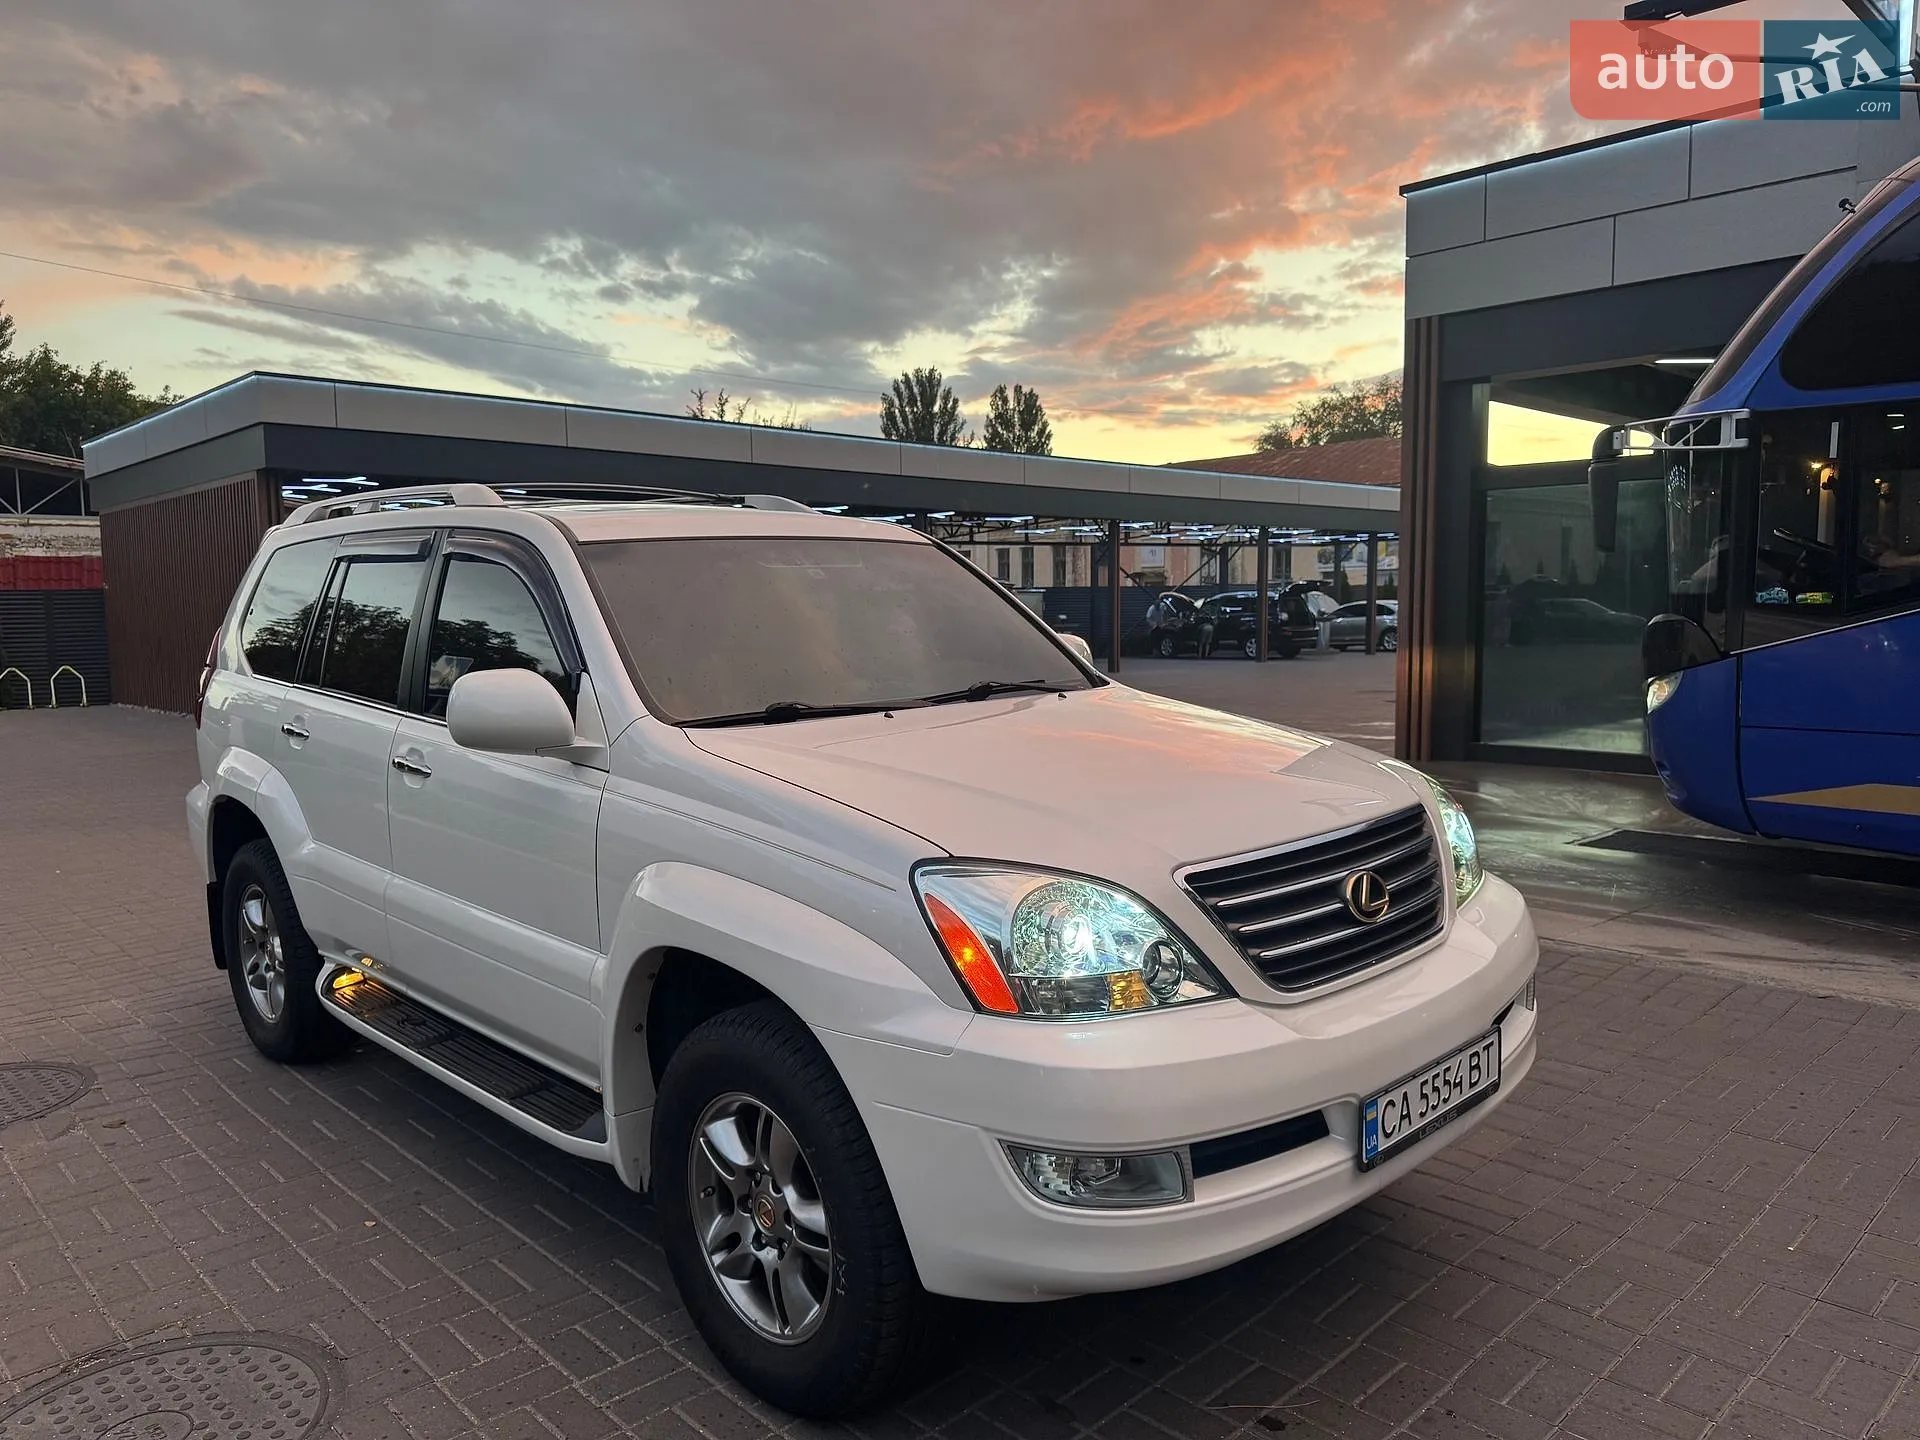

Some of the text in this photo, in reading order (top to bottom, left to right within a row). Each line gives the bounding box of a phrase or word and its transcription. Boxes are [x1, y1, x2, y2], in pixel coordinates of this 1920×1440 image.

[1381, 1040, 1494, 1139] CA 5554 BT
[1366, 1134, 1378, 1149] UA
